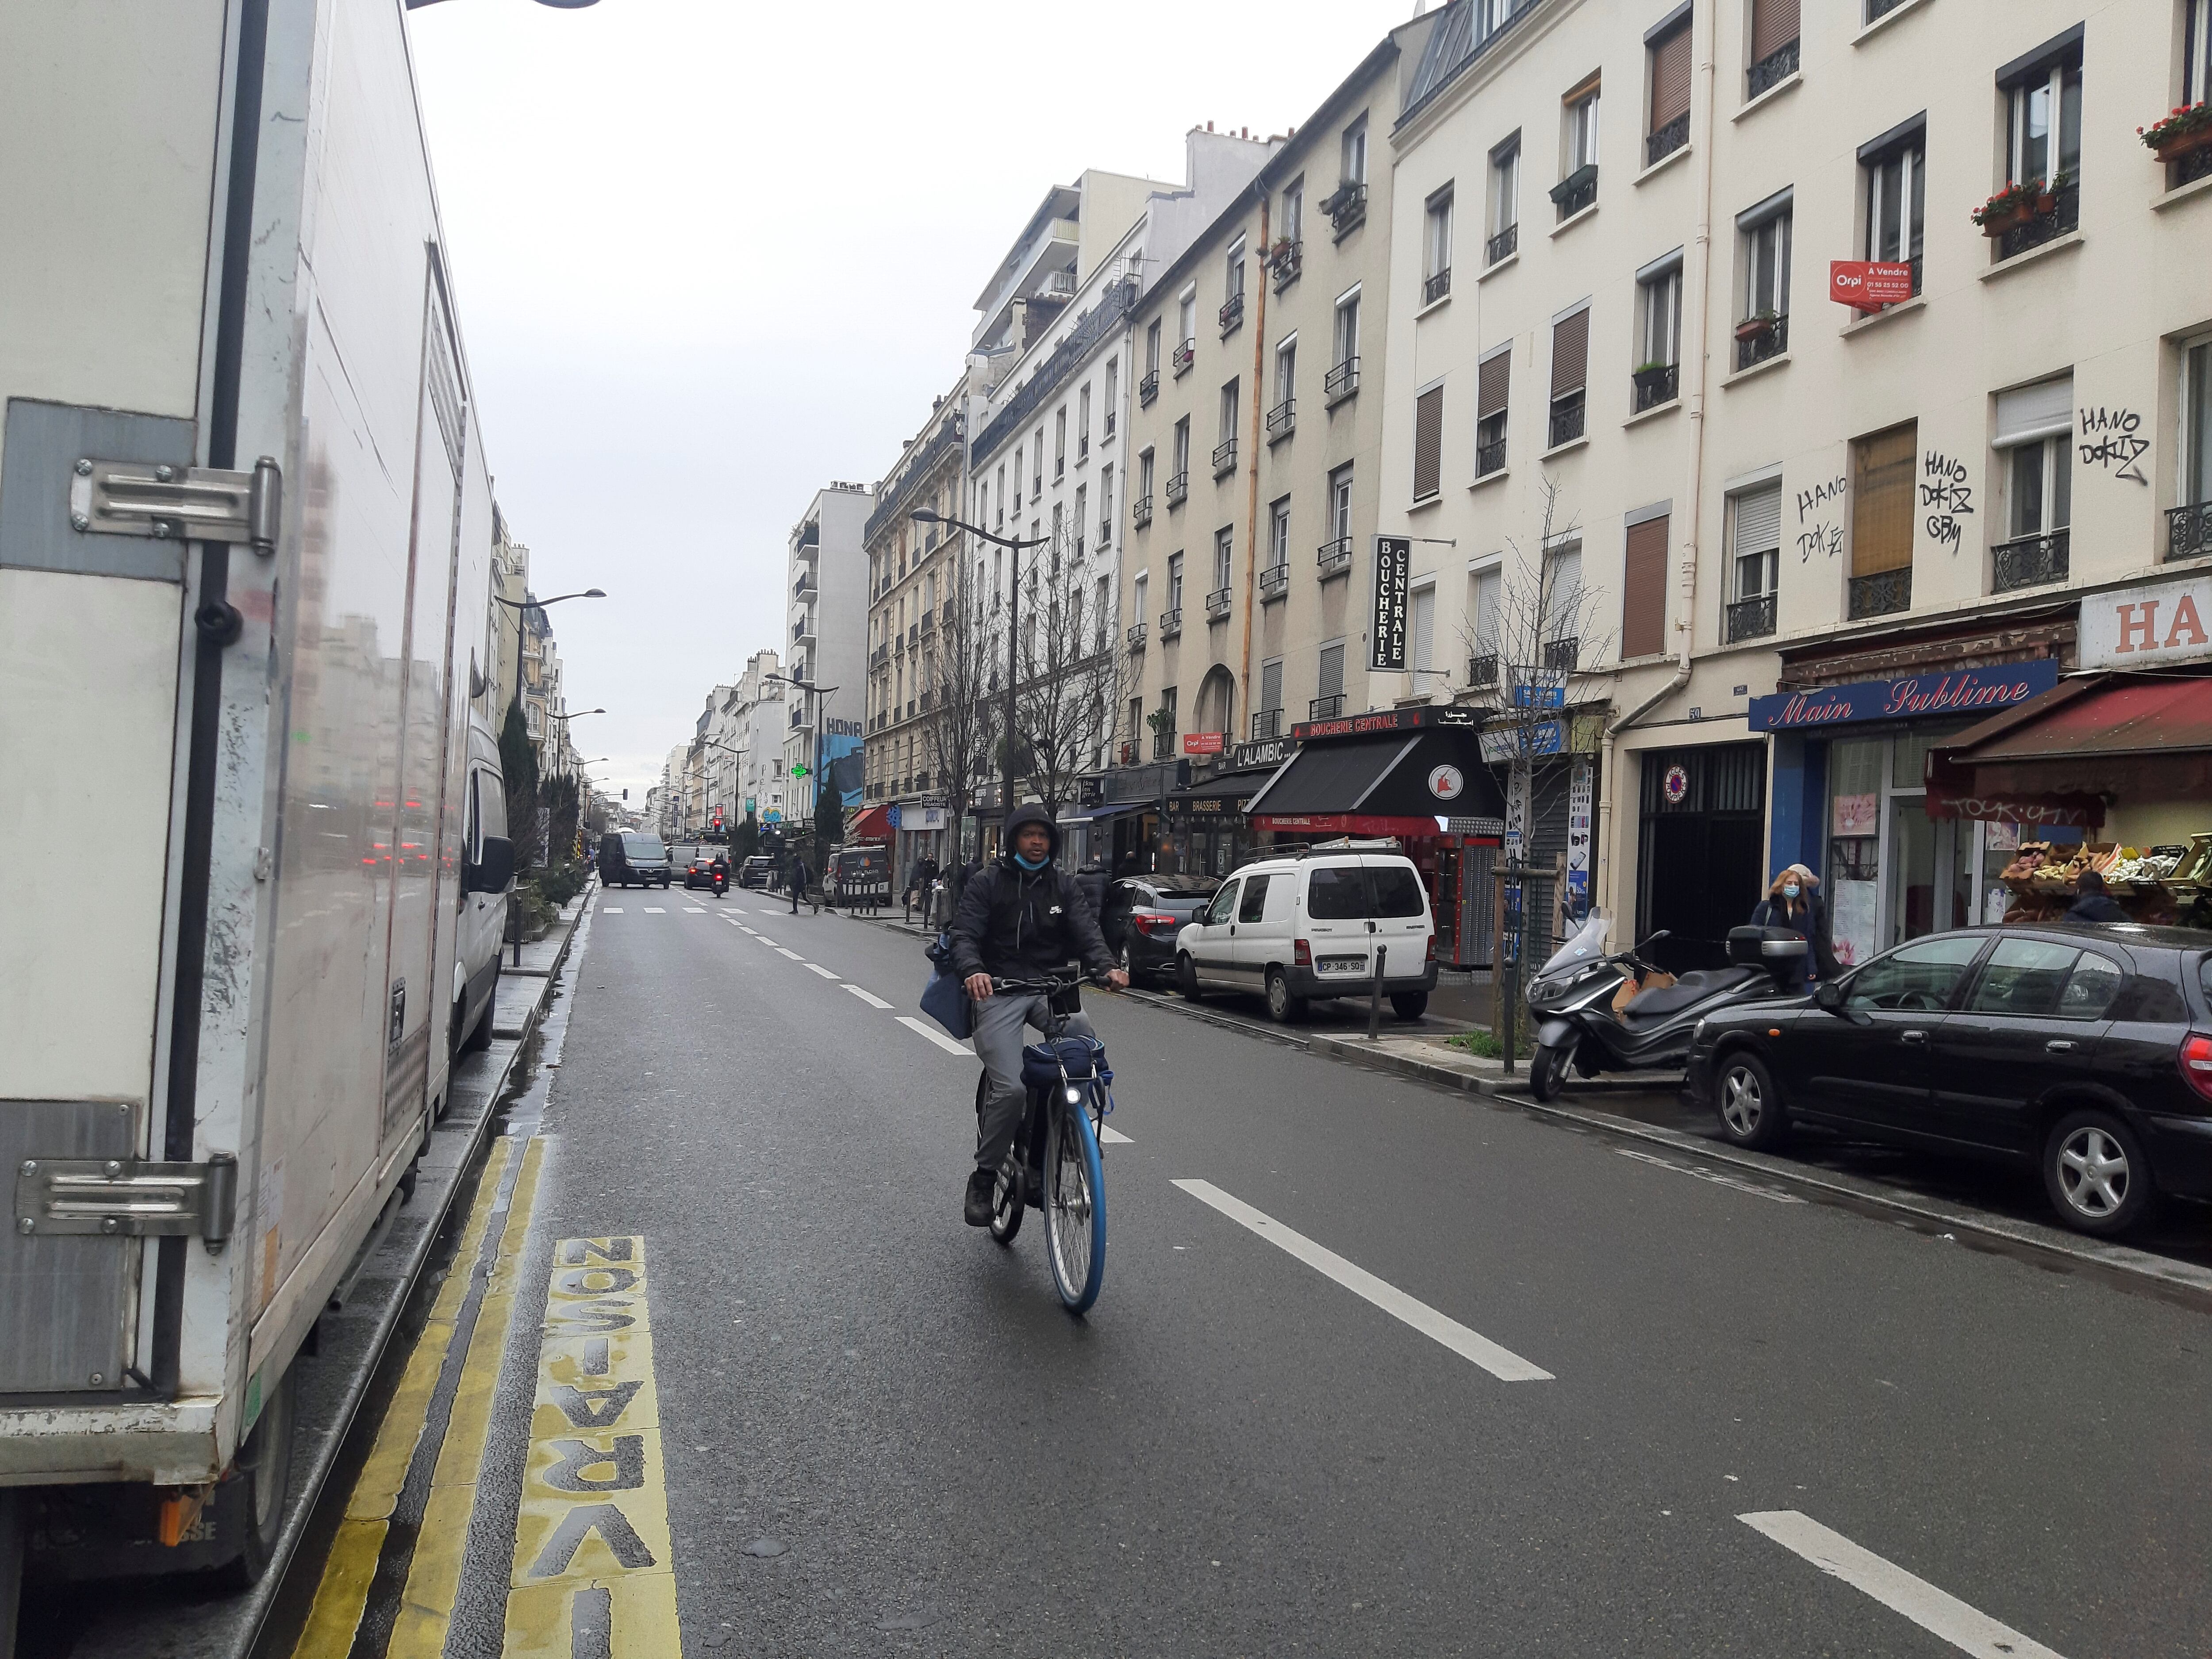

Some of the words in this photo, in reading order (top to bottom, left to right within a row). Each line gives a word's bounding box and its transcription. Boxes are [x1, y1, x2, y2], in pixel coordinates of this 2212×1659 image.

[1836, 274, 1862, 288] Orpi
[1877, 267, 1908, 276] Vendre
[2080, 407, 2141, 435] HANO
[1925, 450, 1967, 483] HANO
[1797, 475, 1847, 525] HANO
[1376, 541, 1392, 667] BOUCHERIE
[1391, 548, 1407, 661] CENTRALE
[2114, 592, 2209, 654] HA
[1767, 693, 1853, 726] Main
[1883, 673, 2031, 715] Sublime
[1310, 719, 1353, 737] BOUCHERIE
[1355, 714, 1398, 733] CENTRALE
[1218, 761, 1226, 771] BAR
[1169, 801, 1179, 812] BAR
[1192, 799, 1221, 812] BRASSERIE
